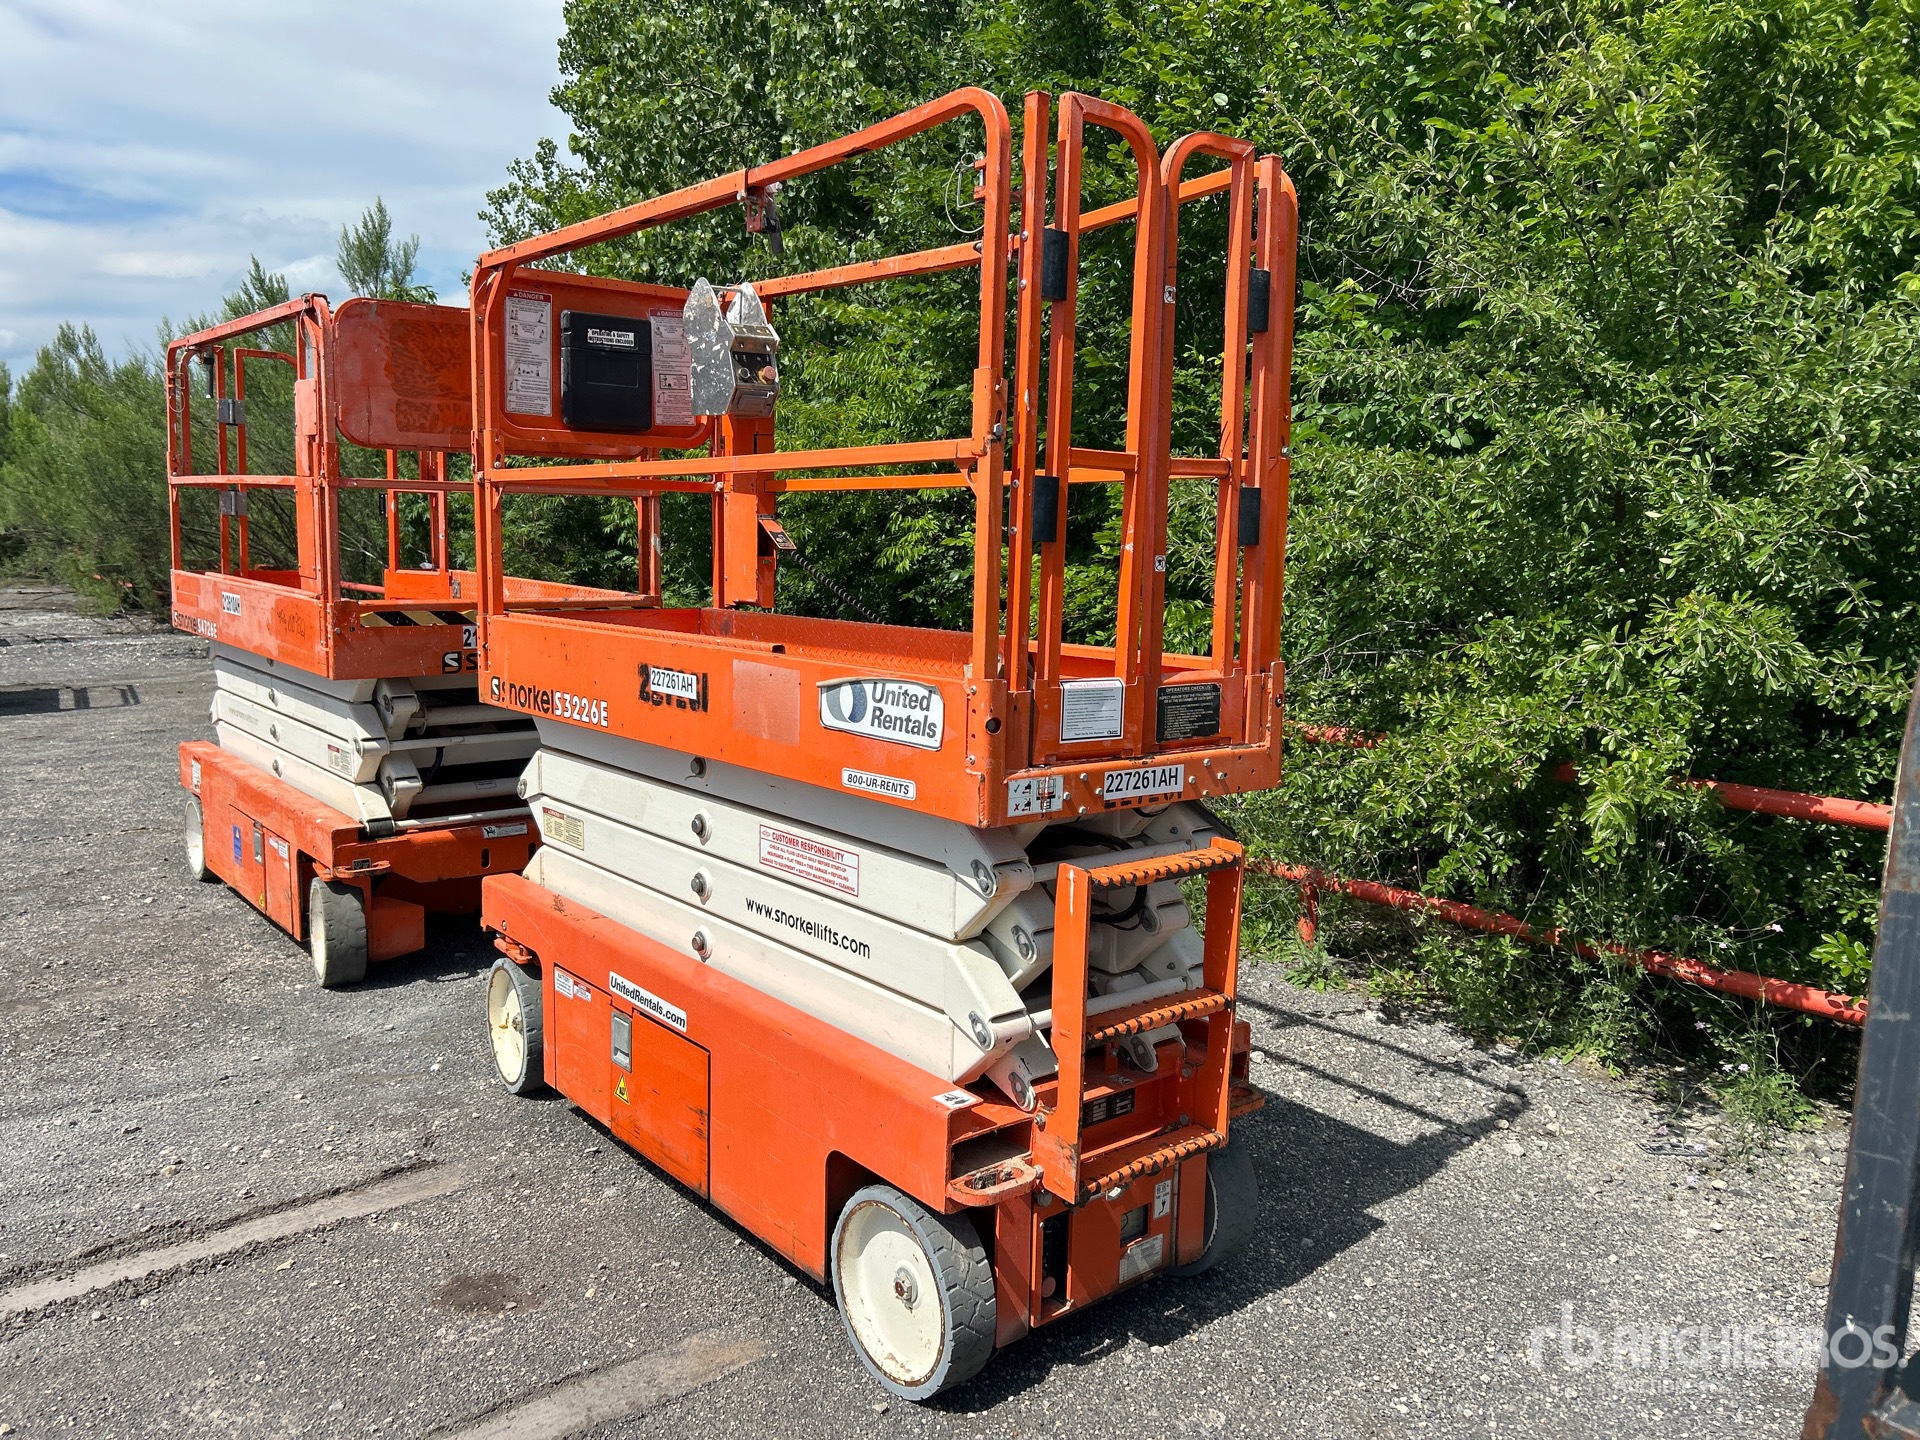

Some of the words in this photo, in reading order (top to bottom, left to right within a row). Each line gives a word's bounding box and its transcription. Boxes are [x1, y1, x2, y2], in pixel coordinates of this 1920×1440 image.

[651, 670, 693, 693] 227261AH
[554, 691, 608, 728] S3226E
[871, 682, 933, 712] United
[870, 706, 938, 738] Rentals
[847, 774, 910, 795] 800-UR-RENTS
[1106, 767, 1178, 793] 227261AH
[772, 832, 800, 848] CUSTOMER
[800, 841, 844, 862] RESPONSIBILITY
[746, 897, 871, 959] www.snorkellifts.com
[610, 975, 686, 1028] UnitedRentals.com
